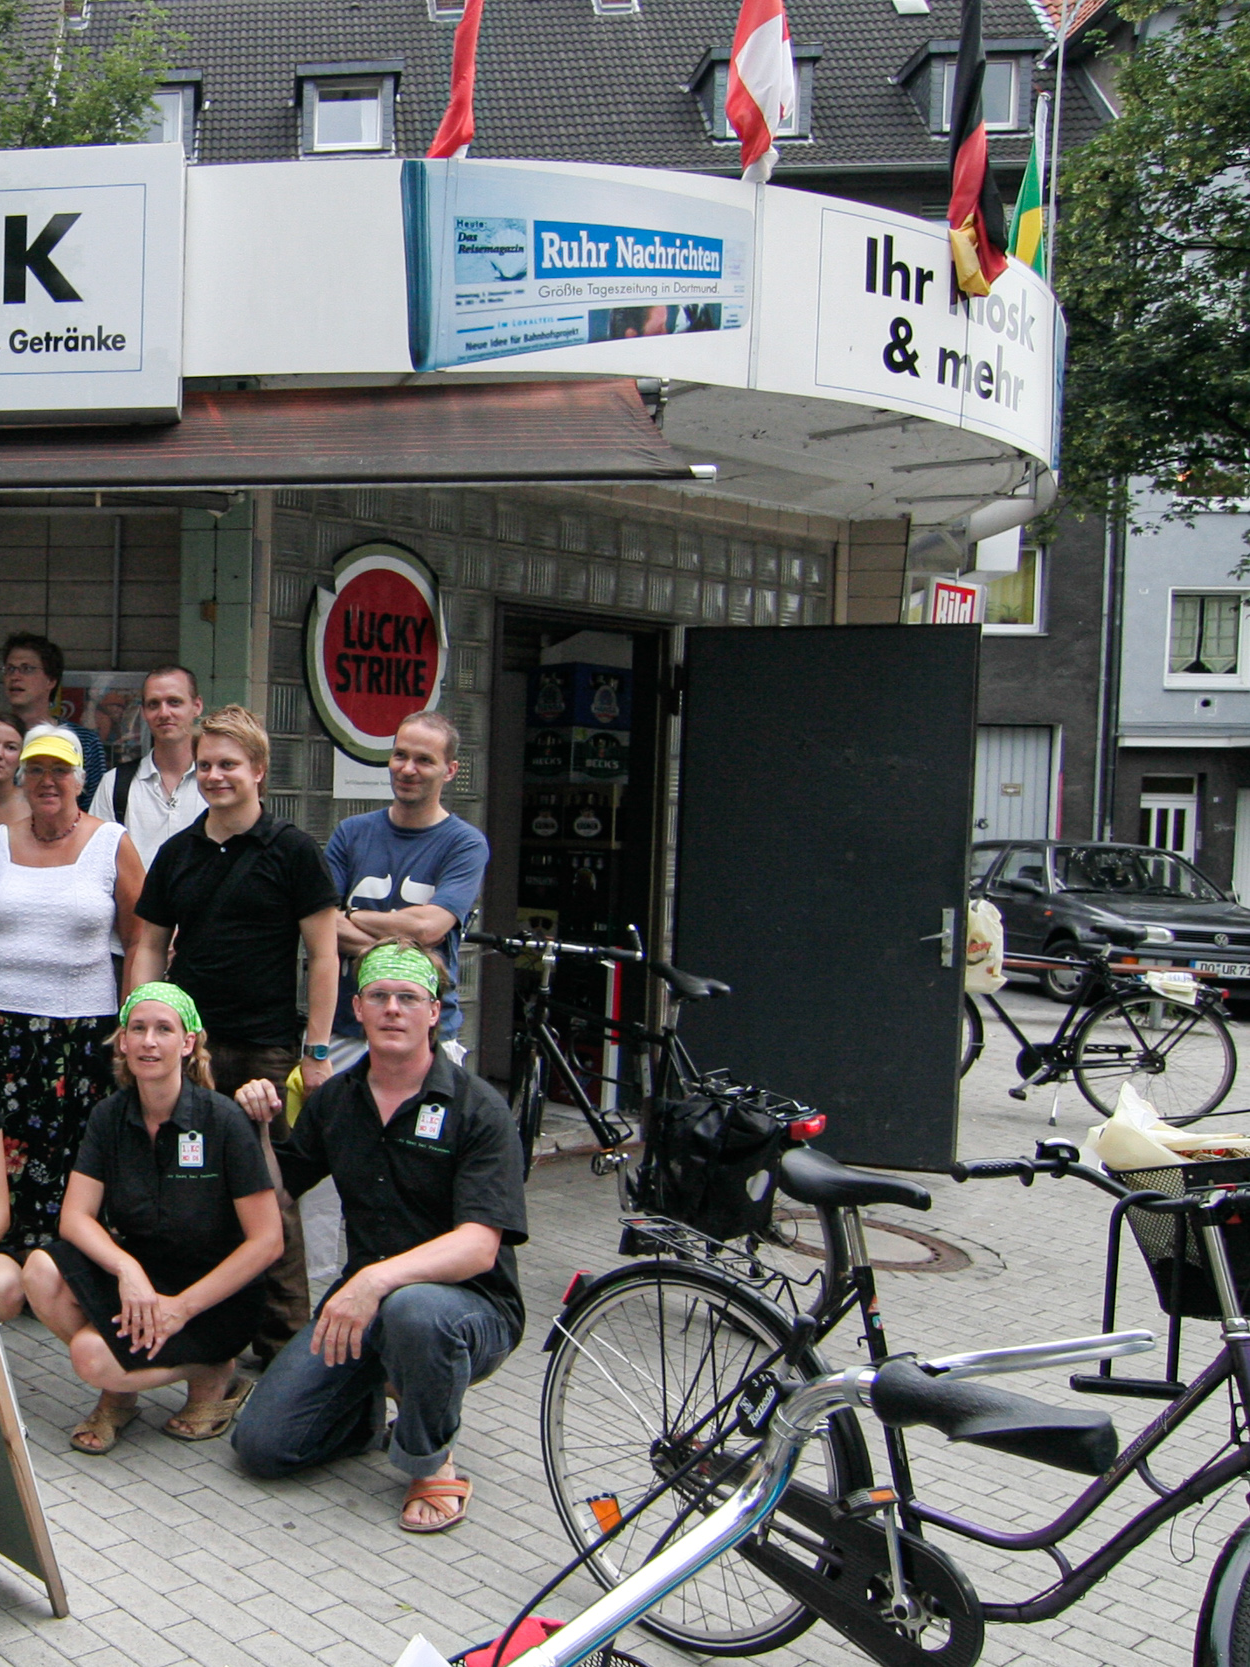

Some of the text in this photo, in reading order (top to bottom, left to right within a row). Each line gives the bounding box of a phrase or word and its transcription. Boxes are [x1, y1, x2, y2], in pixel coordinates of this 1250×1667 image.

[457, 232, 478, 242] Das
[457, 244, 525, 256] Reisemagazin
[541, 230, 721, 273] Ruhr Nachrichten
[865, 233, 934, 306] Ihr
[538, 283, 583, 299] Größte
[588, 283, 658, 297] Tageszeitung
[661, 283, 670, 294] in
[674, 282, 720, 294] Dortmund.
[8, 325, 126, 354] Getränke
[882, 316, 1025, 412] & mehr
[936, 589, 973, 624] Bild
[343, 609, 429, 655] LUCKY
[335, 652, 427, 698] STRIKE
